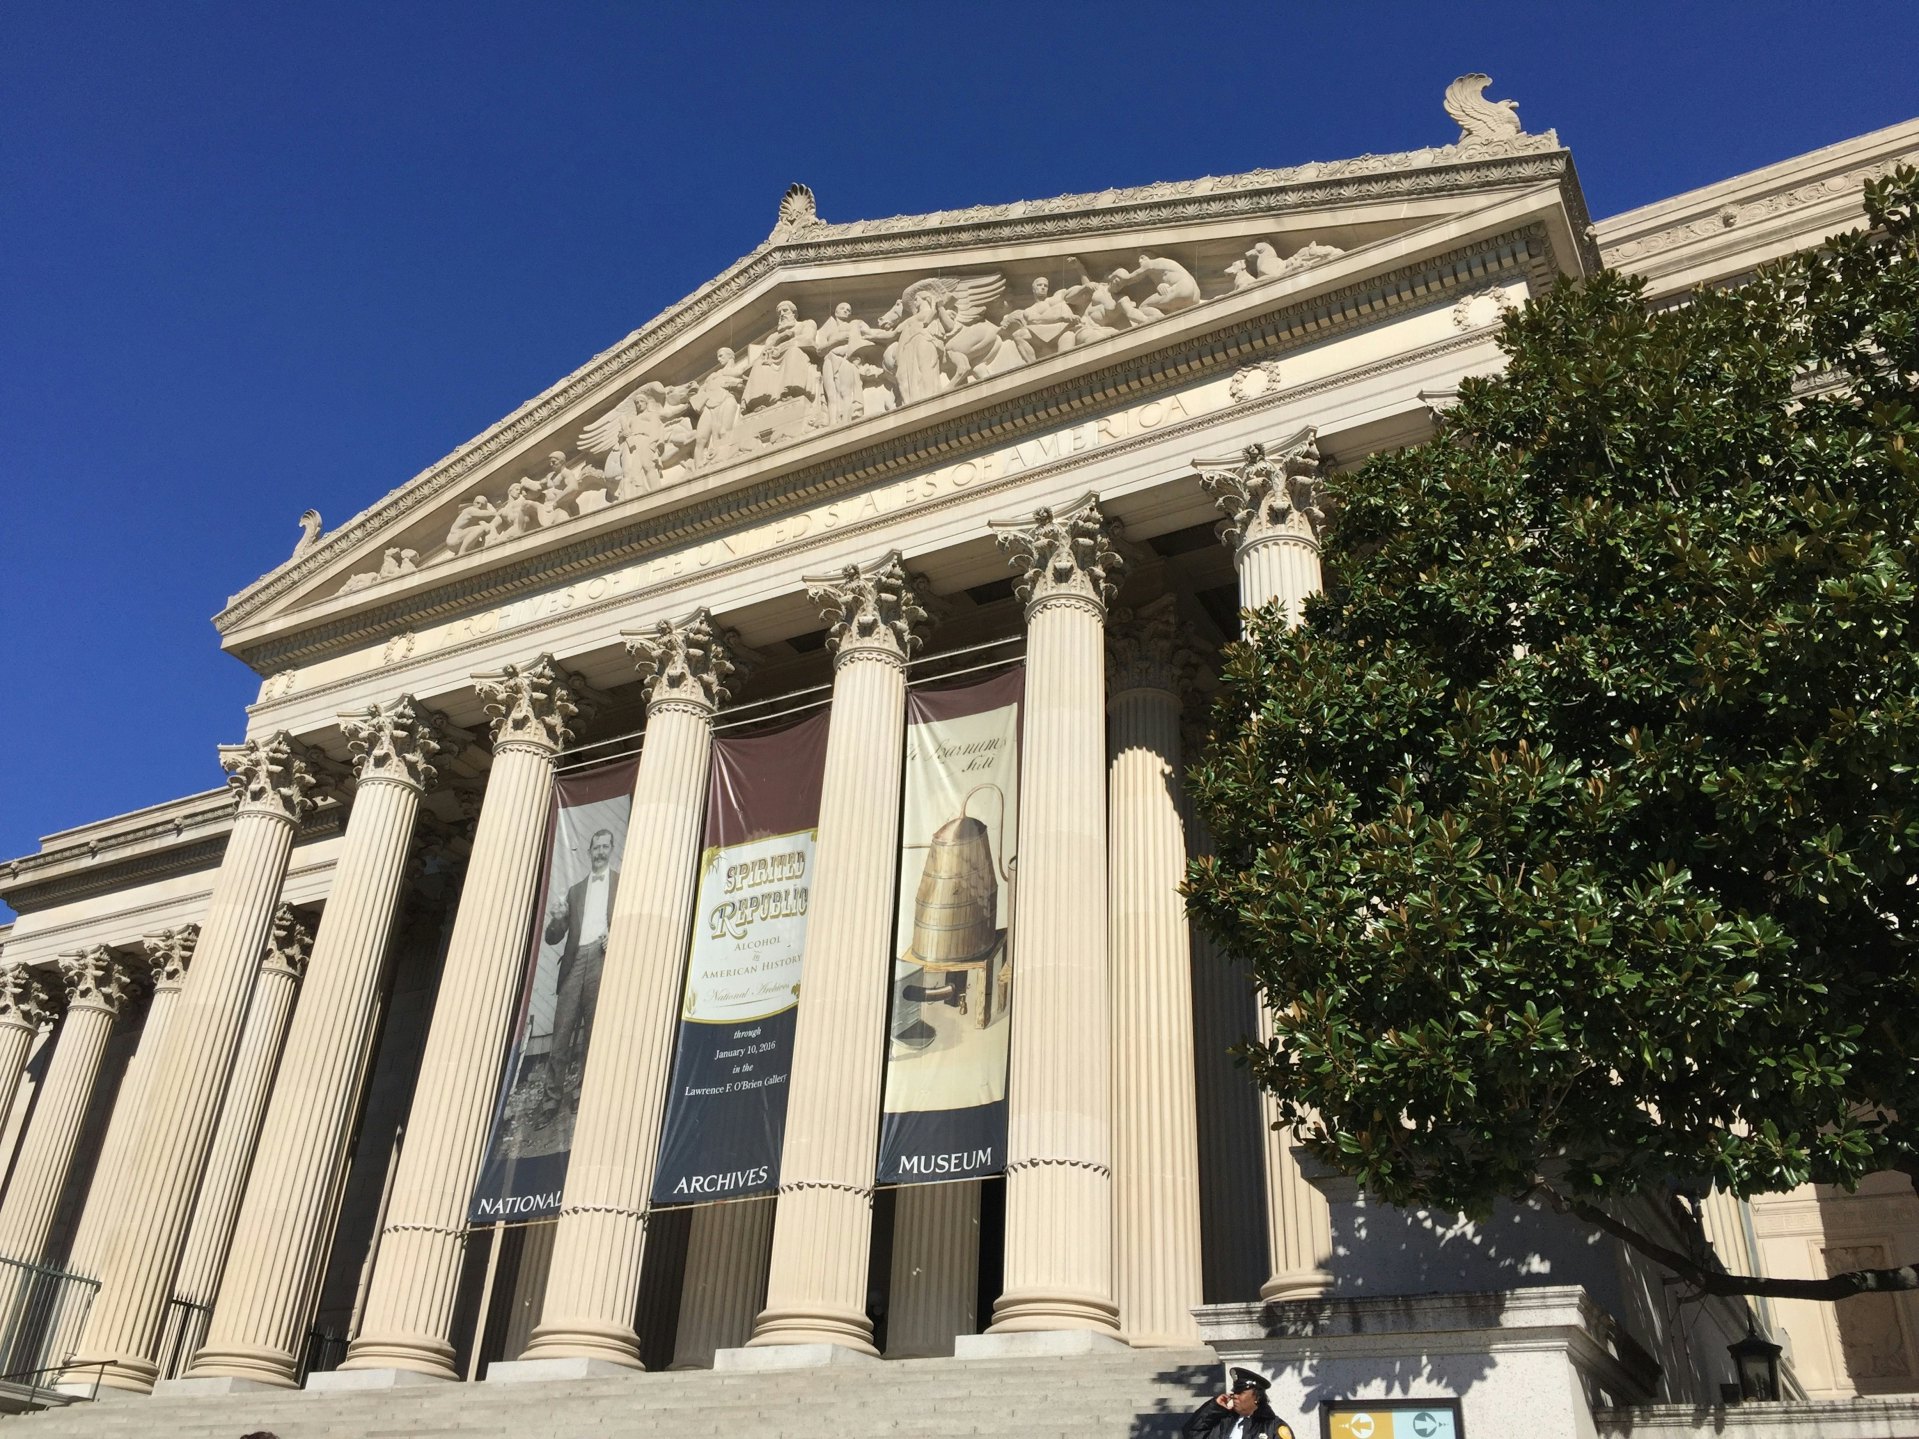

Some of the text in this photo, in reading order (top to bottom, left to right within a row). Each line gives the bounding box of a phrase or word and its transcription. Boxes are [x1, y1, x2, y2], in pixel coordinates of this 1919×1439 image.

[439, 394, 1191, 647] ARCHIVES OF THE UNITED STATES OF AMERICA
[724, 851, 805, 894] SPIRITED
[709, 886, 808, 940] REPUBLIC
[733, 1027, 761, 1039] through
[714, 1040, 776, 1060] January 10, 2016
[732, 1062, 754, 1074] in the
[685, 1084, 724, 1096] Lawrence
[725, 1082, 732, 1092] F.
[734, 1079, 763, 1092] O'Brien
[477, 1146, 992, 1216] NATIONAL ARCHIVES MUSEUM
